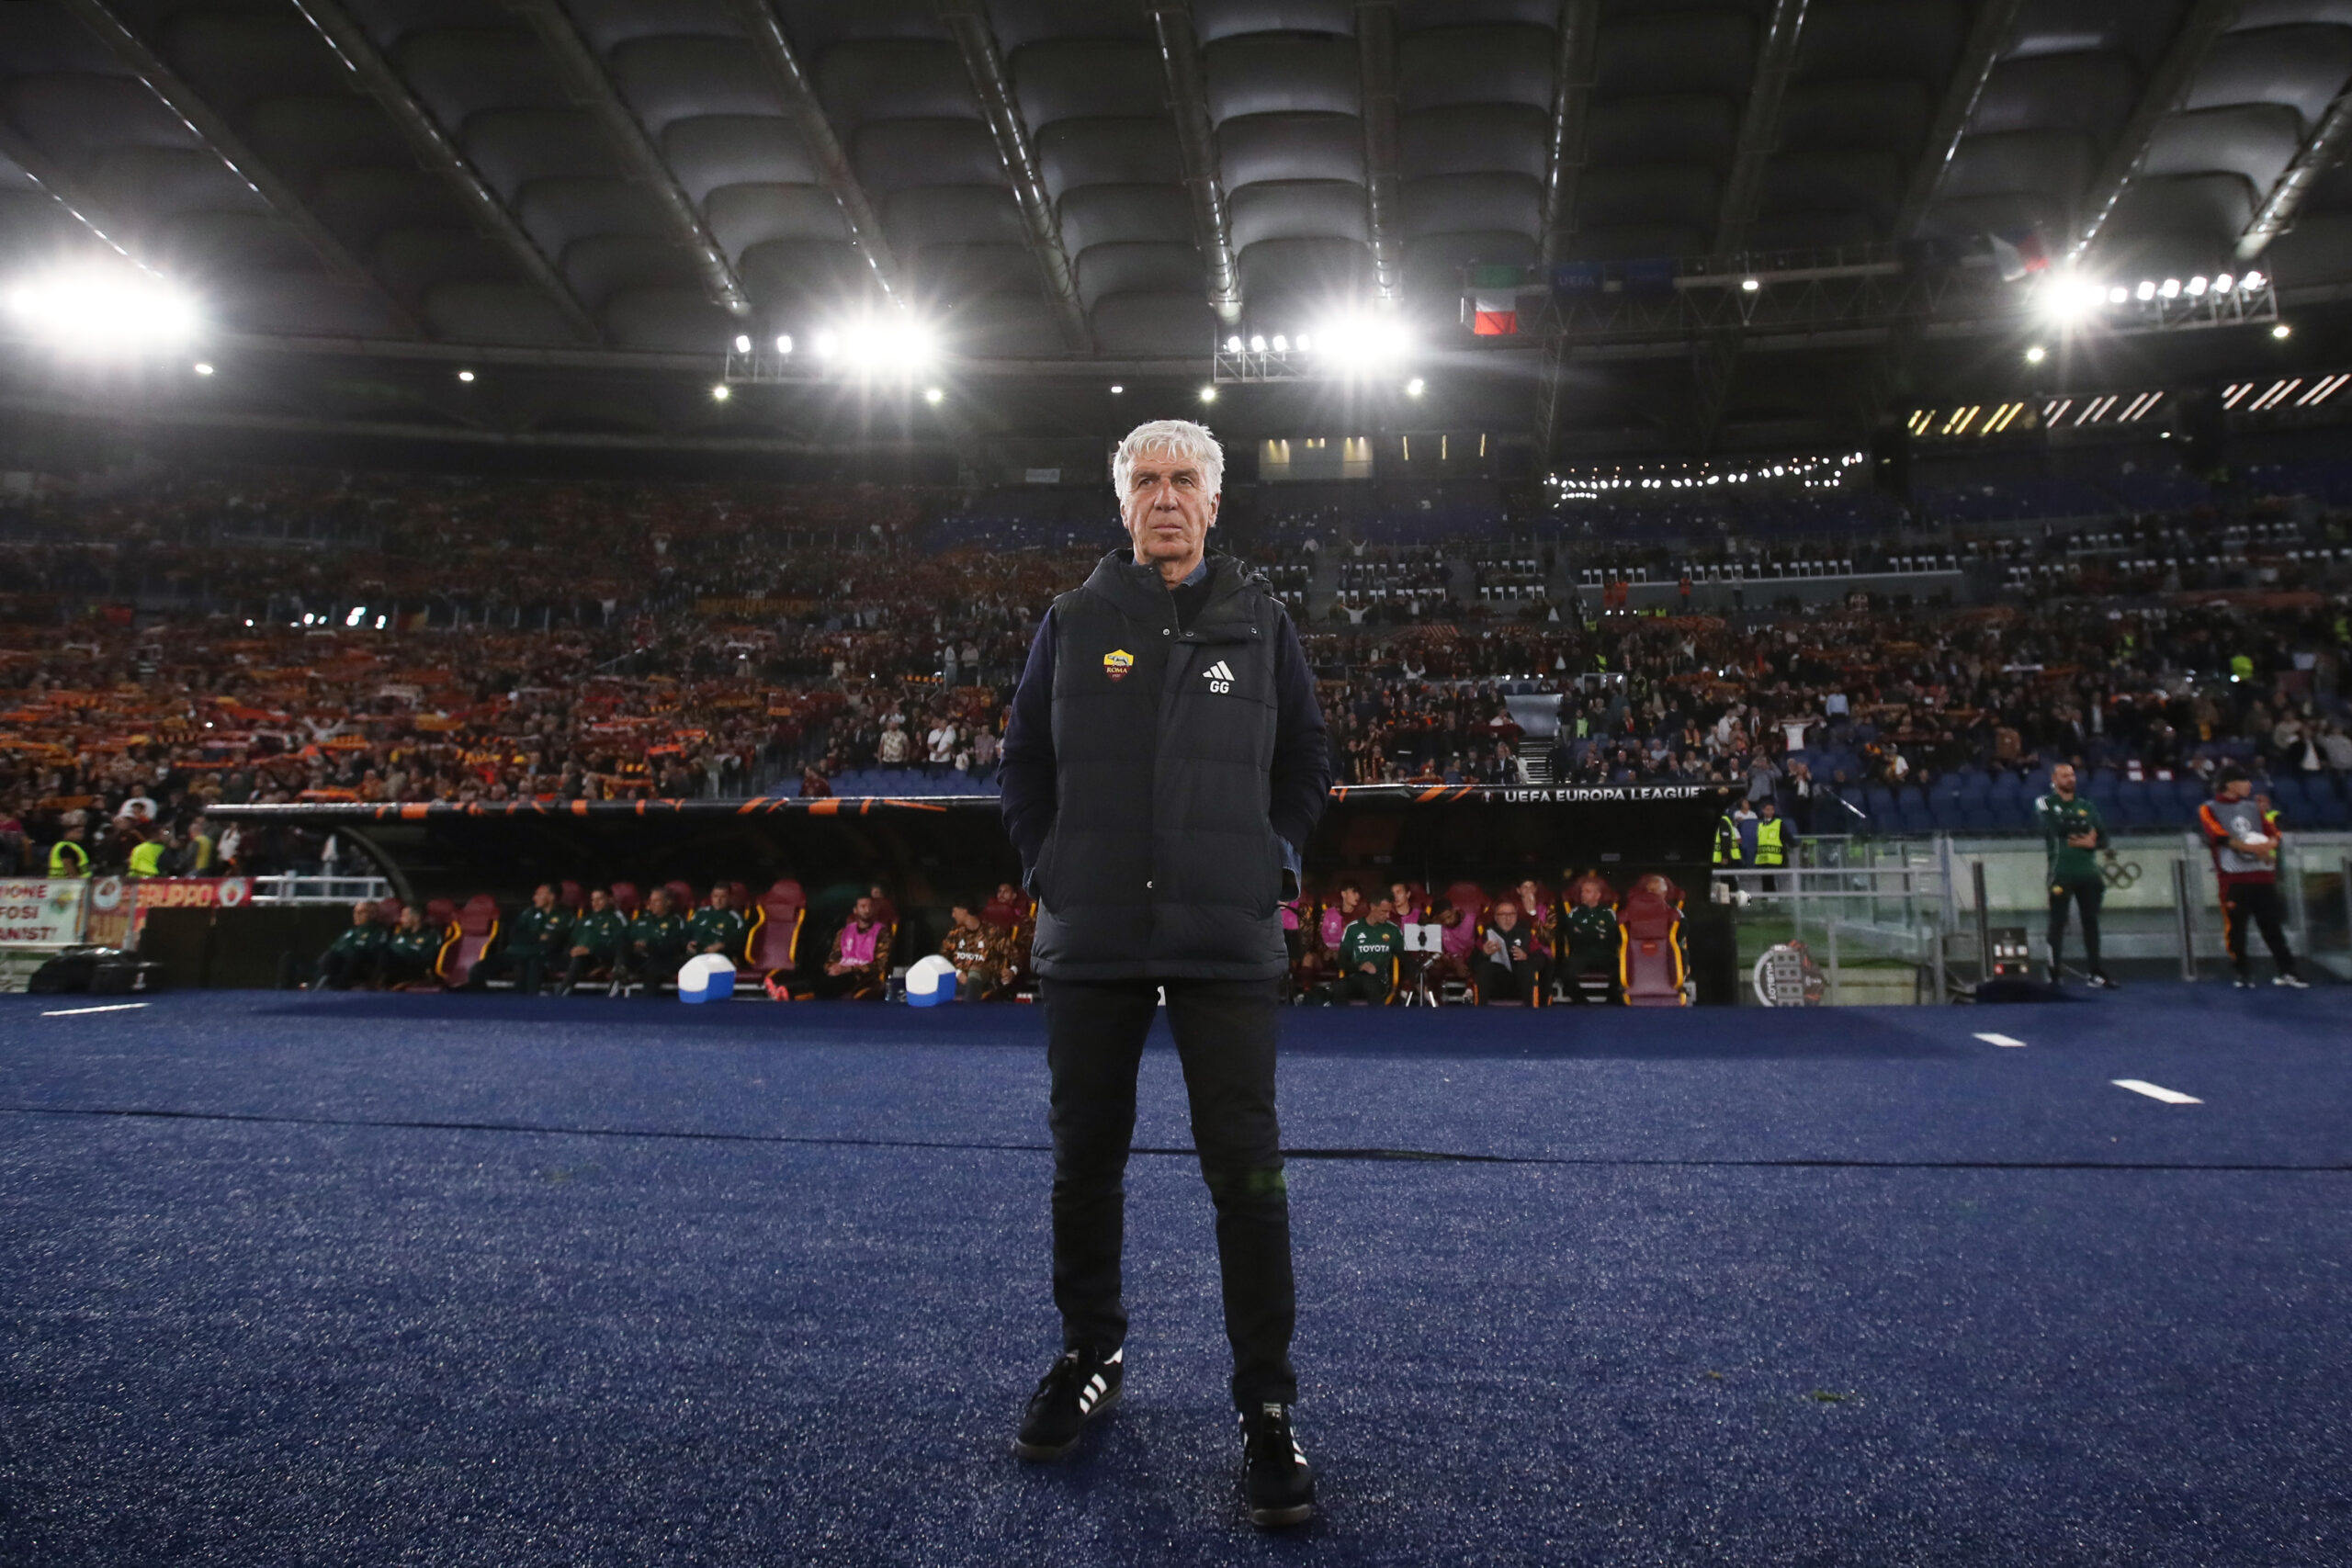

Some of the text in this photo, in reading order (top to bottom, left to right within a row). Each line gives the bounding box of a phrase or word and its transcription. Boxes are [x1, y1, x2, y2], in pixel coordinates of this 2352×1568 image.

[1557, 276, 1596, 288] UEFA
[1209, 681, 1229, 694] GG
[1505, 786, 1700, 803] UEFA EUROPA LEAGUE
[0, 885, 47, 898] IONE
[956, 953, 985, 962] TOYOTA
[1766, 962, 1777, 1000] HUBLOT
